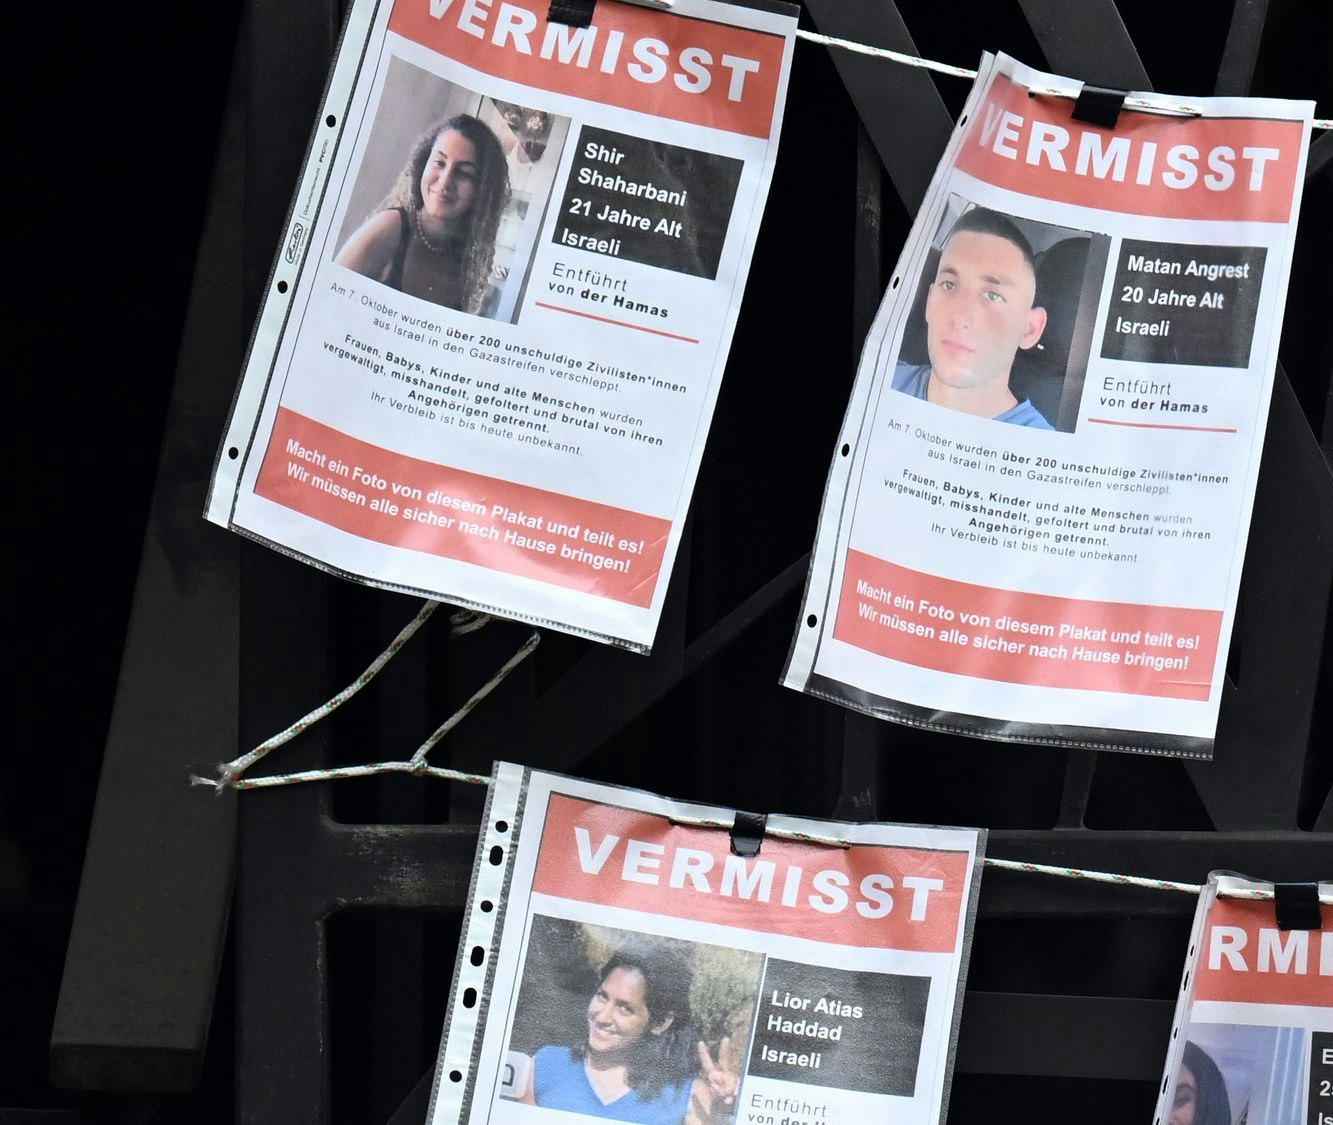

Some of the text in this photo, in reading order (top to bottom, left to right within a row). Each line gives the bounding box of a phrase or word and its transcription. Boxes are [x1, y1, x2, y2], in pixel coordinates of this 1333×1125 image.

[428, 0, 760, 103] VERMISST
[583, 141, 625, 165] Shir
[978, 102, 1280, 192] VERMISST
[577, 166, 688, 207] Shaharbani
[568, 197, 683, 239] 21 Jahre Alt
[560, 227, 621, 256] Israeli
[551, 261, 628, 293] Entführt
[1126, 254, 1250, 282] Matan Angrest
[548, 281, 668, 318] von der Hamas
[1120, 285, 1225, 310] 20 Jahre Alt
[1115, 315, 1170, 337] Israeli
[573, 827, 943, 921] VERMISST
[770, 989, 863, 1019] Lior Atias
[766, 1013, 843, 1042] Haddad
[760, 1044, 822, 1069] Israeli
